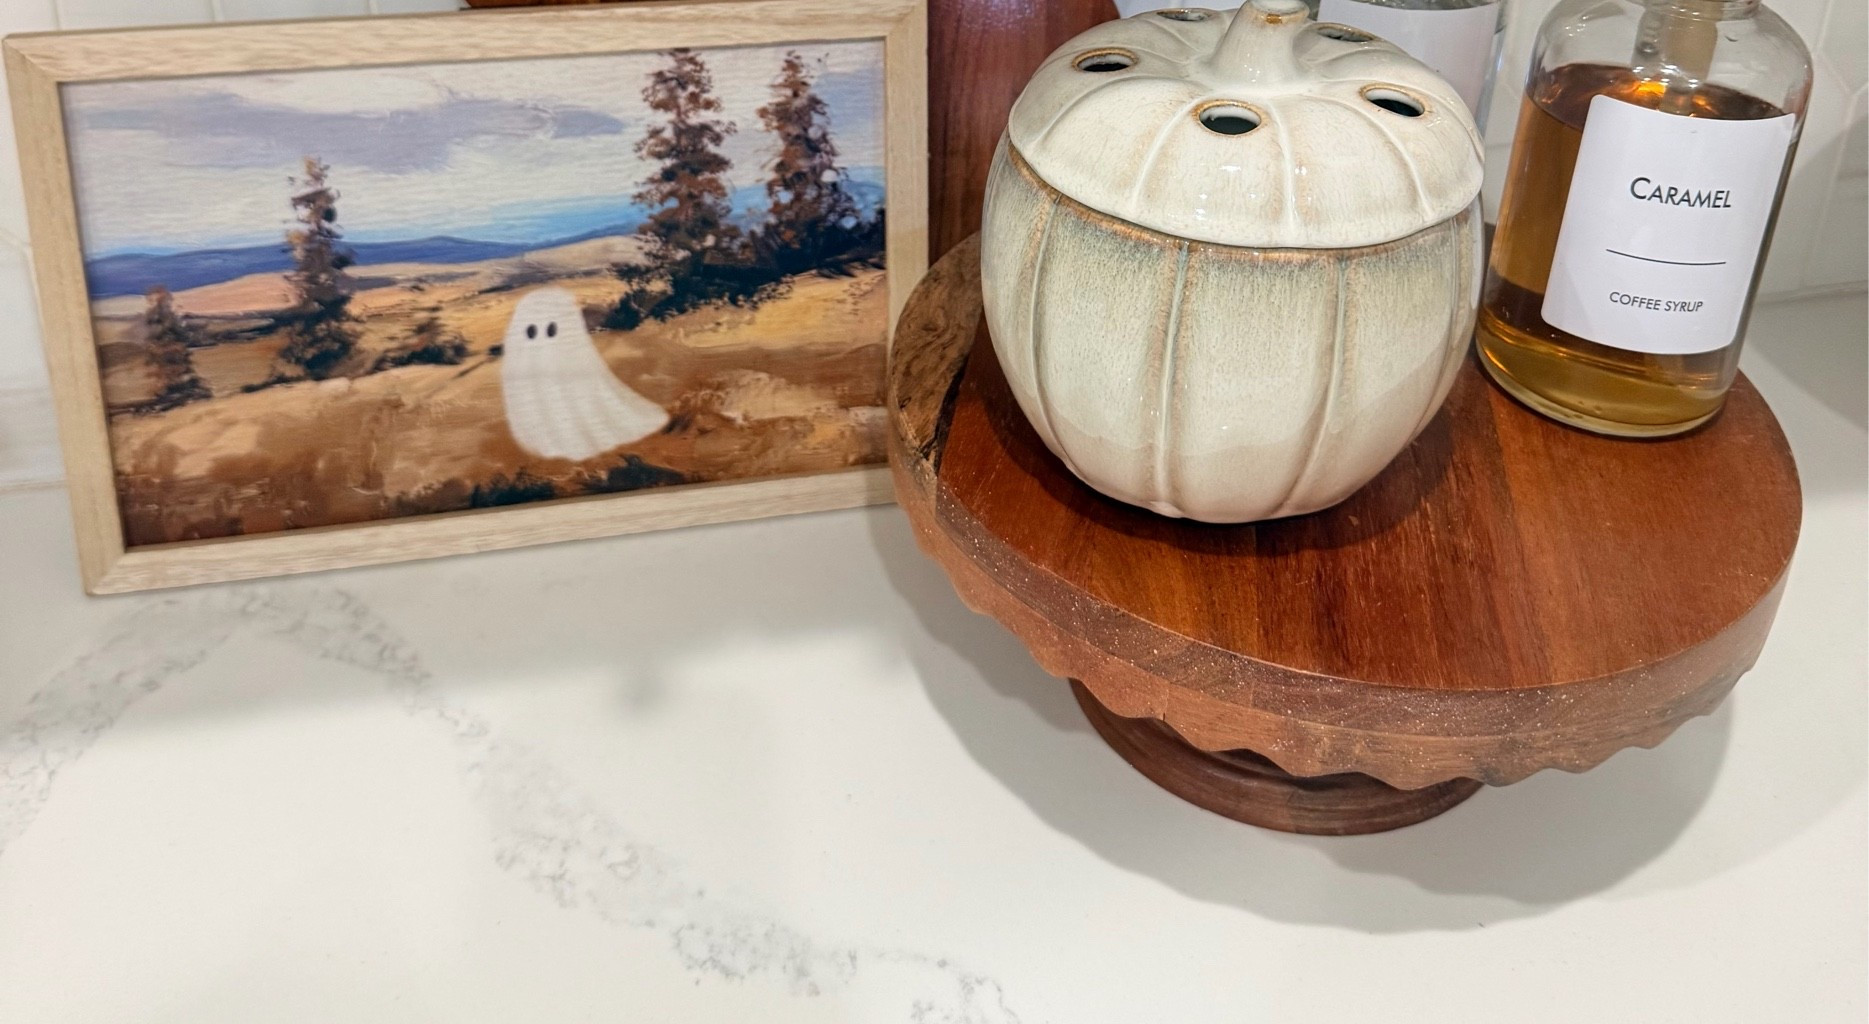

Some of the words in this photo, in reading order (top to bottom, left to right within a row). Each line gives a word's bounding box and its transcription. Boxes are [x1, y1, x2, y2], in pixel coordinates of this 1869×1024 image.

[1630, 177, 1732, 208] CARAMEL
[1609, 291, 1662, 311] COFFEE
[1664, 300, 1703, 312] SYRUP
